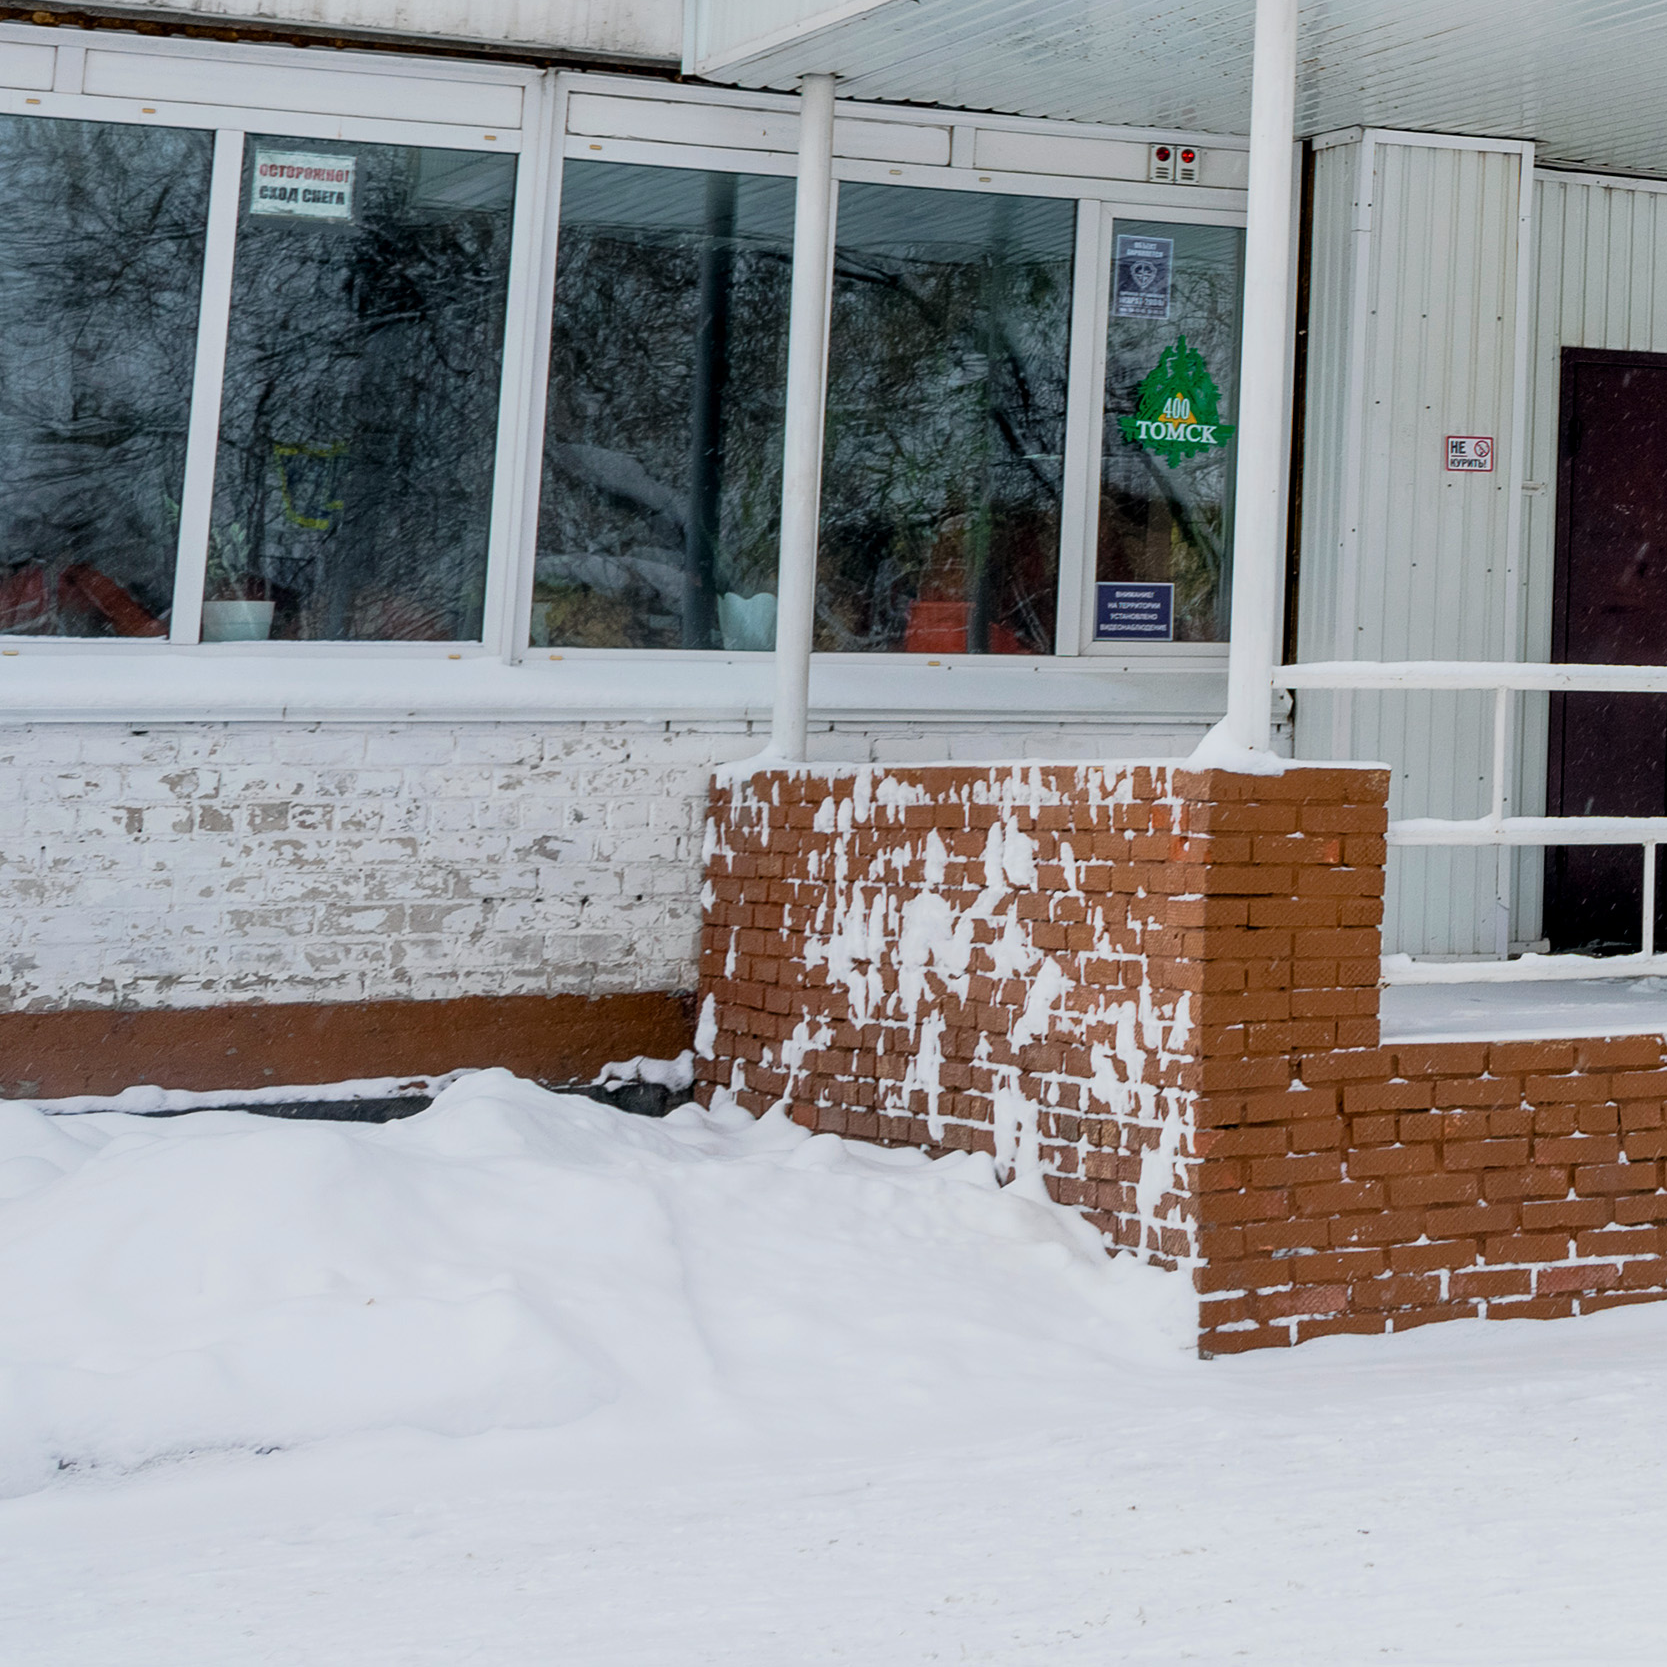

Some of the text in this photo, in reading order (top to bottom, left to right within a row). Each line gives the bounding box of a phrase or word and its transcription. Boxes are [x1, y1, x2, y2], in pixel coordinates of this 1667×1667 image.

[259, 163, 350, 184] ОСТОРОЖНО!
[259, 185, 345, 206] СХОД СНЕГА
[1162, 397, 1190, 420] 400
[1136, 420, 1218, 444] ТОМСК
[1450, 440, 1467, 454] НЕ
[1450, 458, 1487, 469] КУРИТЬ!
[1115, 591, 1155, 599] ВНИМАНИЕ!
[1118, 602, 1161, 610] ТЕРРИТОРИИ
[1110, 613, 1158, 621] УСТАНОВЛЕНО
[1099, 623, 1168, 632] ВИДЕОНАБЛЮДЕНИЕ
